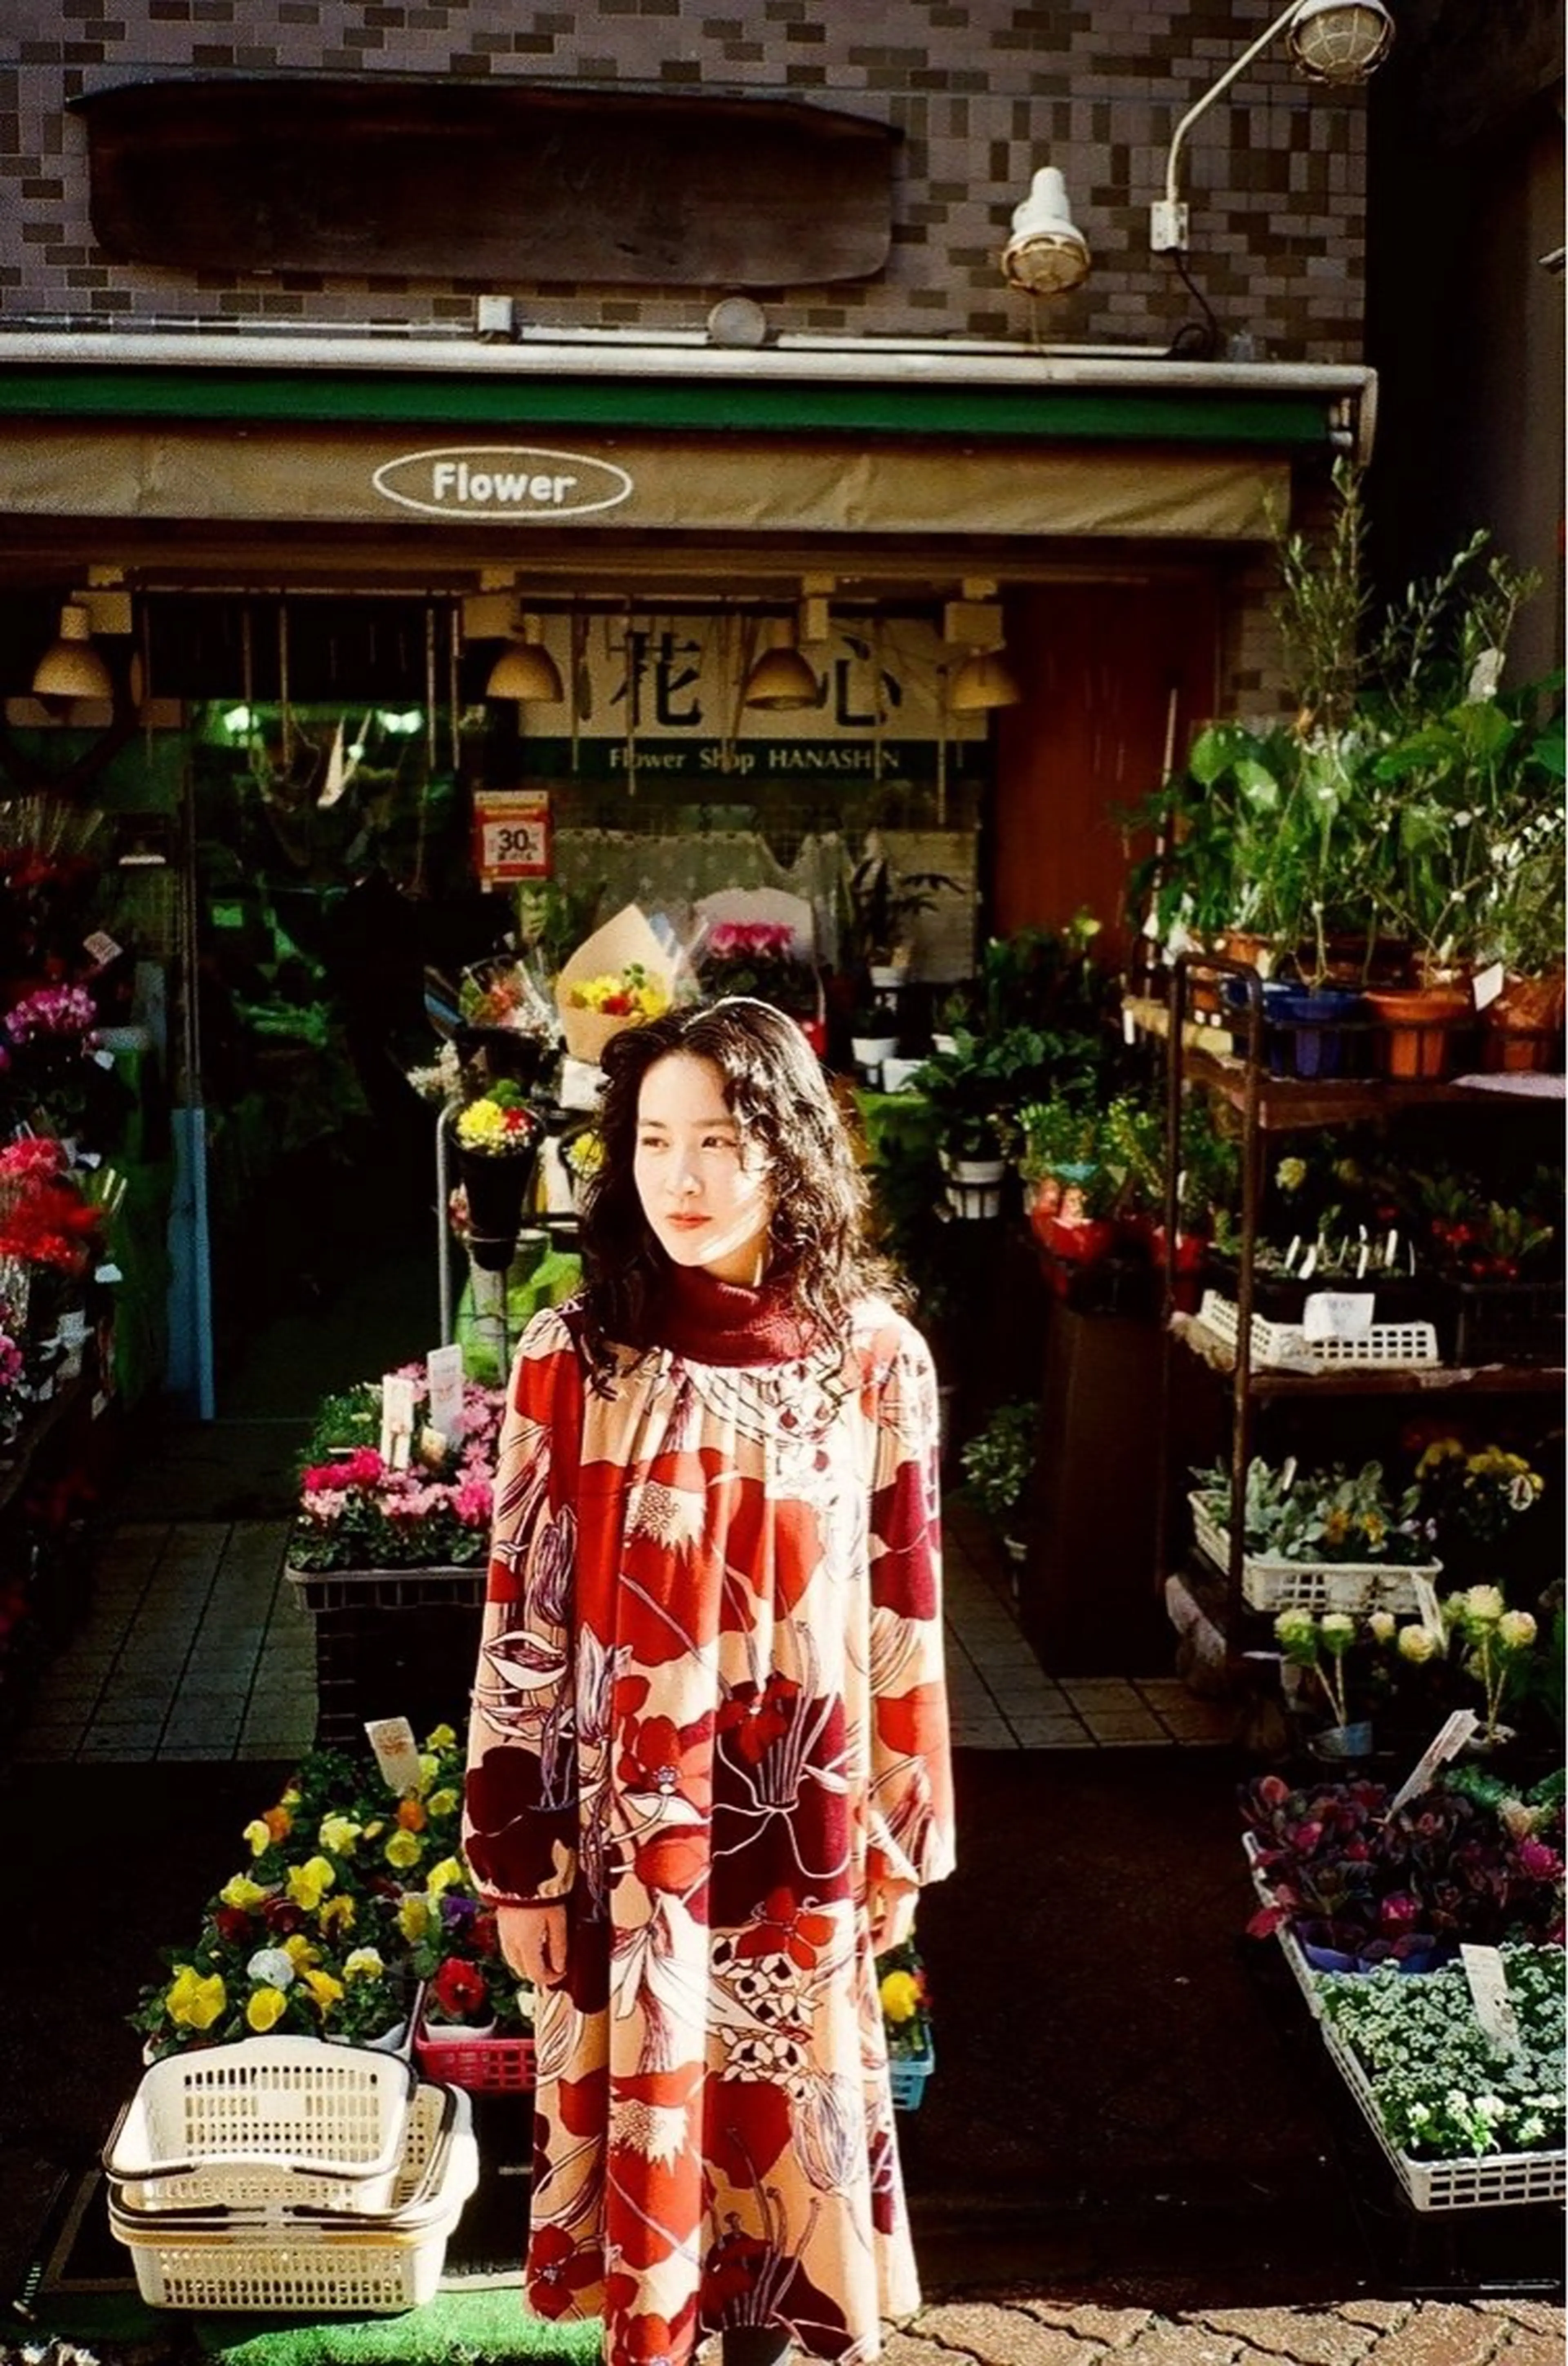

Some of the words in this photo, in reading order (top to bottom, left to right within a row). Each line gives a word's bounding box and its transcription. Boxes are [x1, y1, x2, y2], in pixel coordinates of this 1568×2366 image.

[433, 462, 577, 503] Flower
[609, 631, 901, 727] 花心
[608, 747, 686, 768] Flower
[699, 746, 755, 775] Shop
[769, 748, 899, 769] HANASHN
